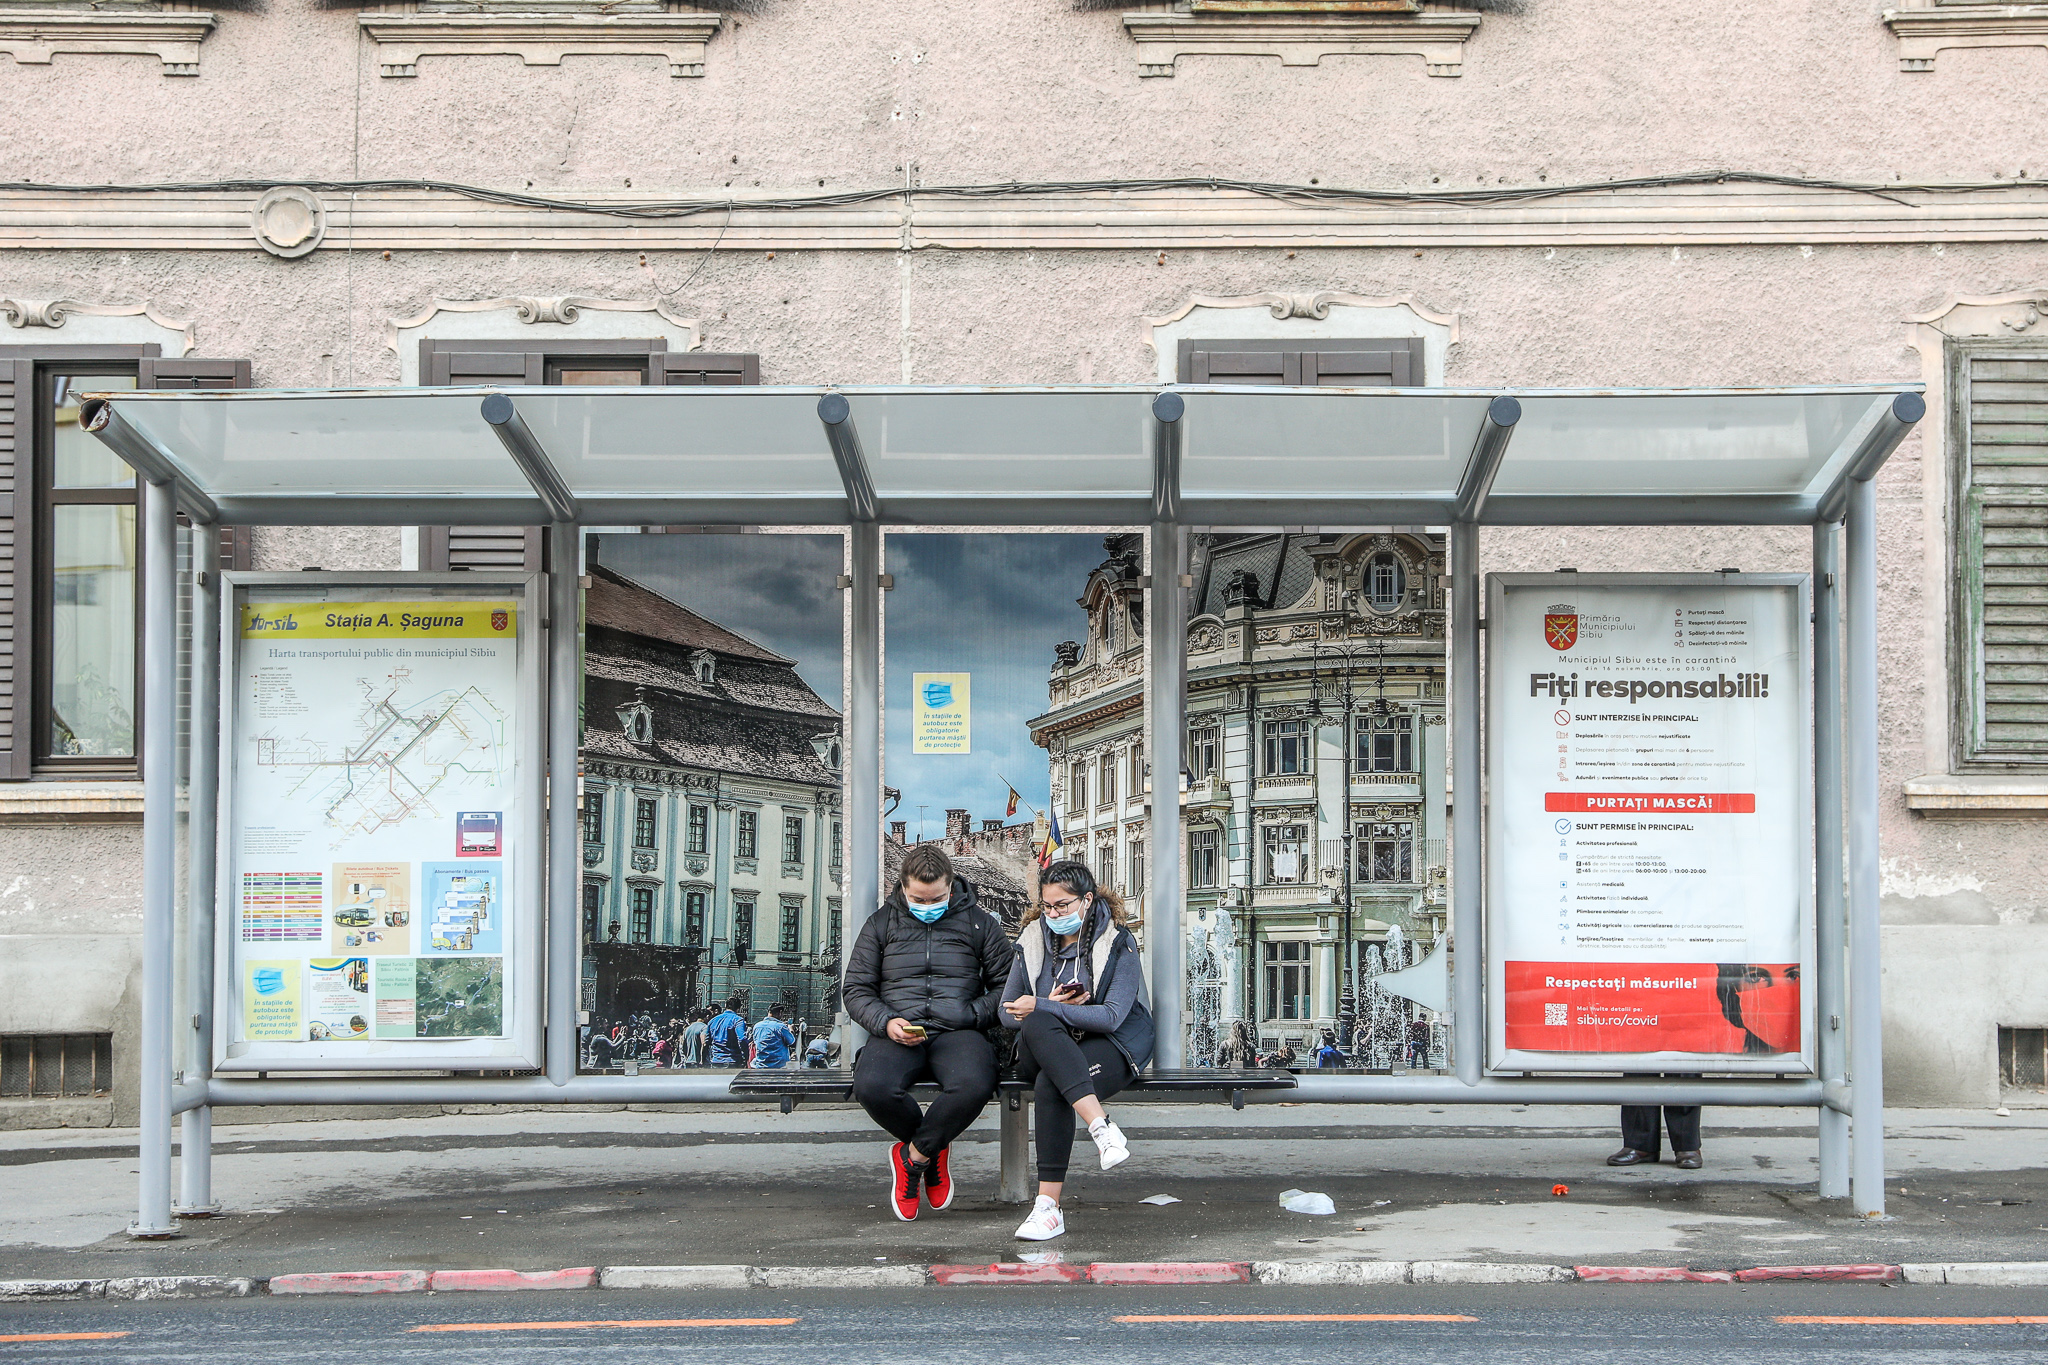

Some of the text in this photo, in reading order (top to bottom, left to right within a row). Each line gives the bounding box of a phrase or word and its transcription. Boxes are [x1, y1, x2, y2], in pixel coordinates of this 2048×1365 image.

[325, 613, 464, 632] Stația A. Șaguna
[1579, 613, 1621, 623] Primăria
[1579, 622, 1636, 632] Municipiului
[1579, 630, 1603, 639] Sibiu
[268, 648, 496, 660] Harta transportului public din municipiul Sibiu
[1558, 655, 1737, 665] Municipiul Sibiu este în carantină
[1529, 672, 1769, 706] Fiți responsabili!
[1575, 712, 1699, 722] SUNT INTERZISE ÎN PRINCIPAL:
[1587, 795, 1714, 811] PURTAȚI MASCĂ!
[1637, 822, 1647, 831] ÎN
[1648, 823, 1694, 832] PRINCIPAL:
[1545, 976, 1698, 992] Respectați măsurile!
[254, 998, 261, 1006] În
[1632, 1005, 1643, 1014] pe:
[1576, 1014, 1658, 1027] sibiu.ro/covid
